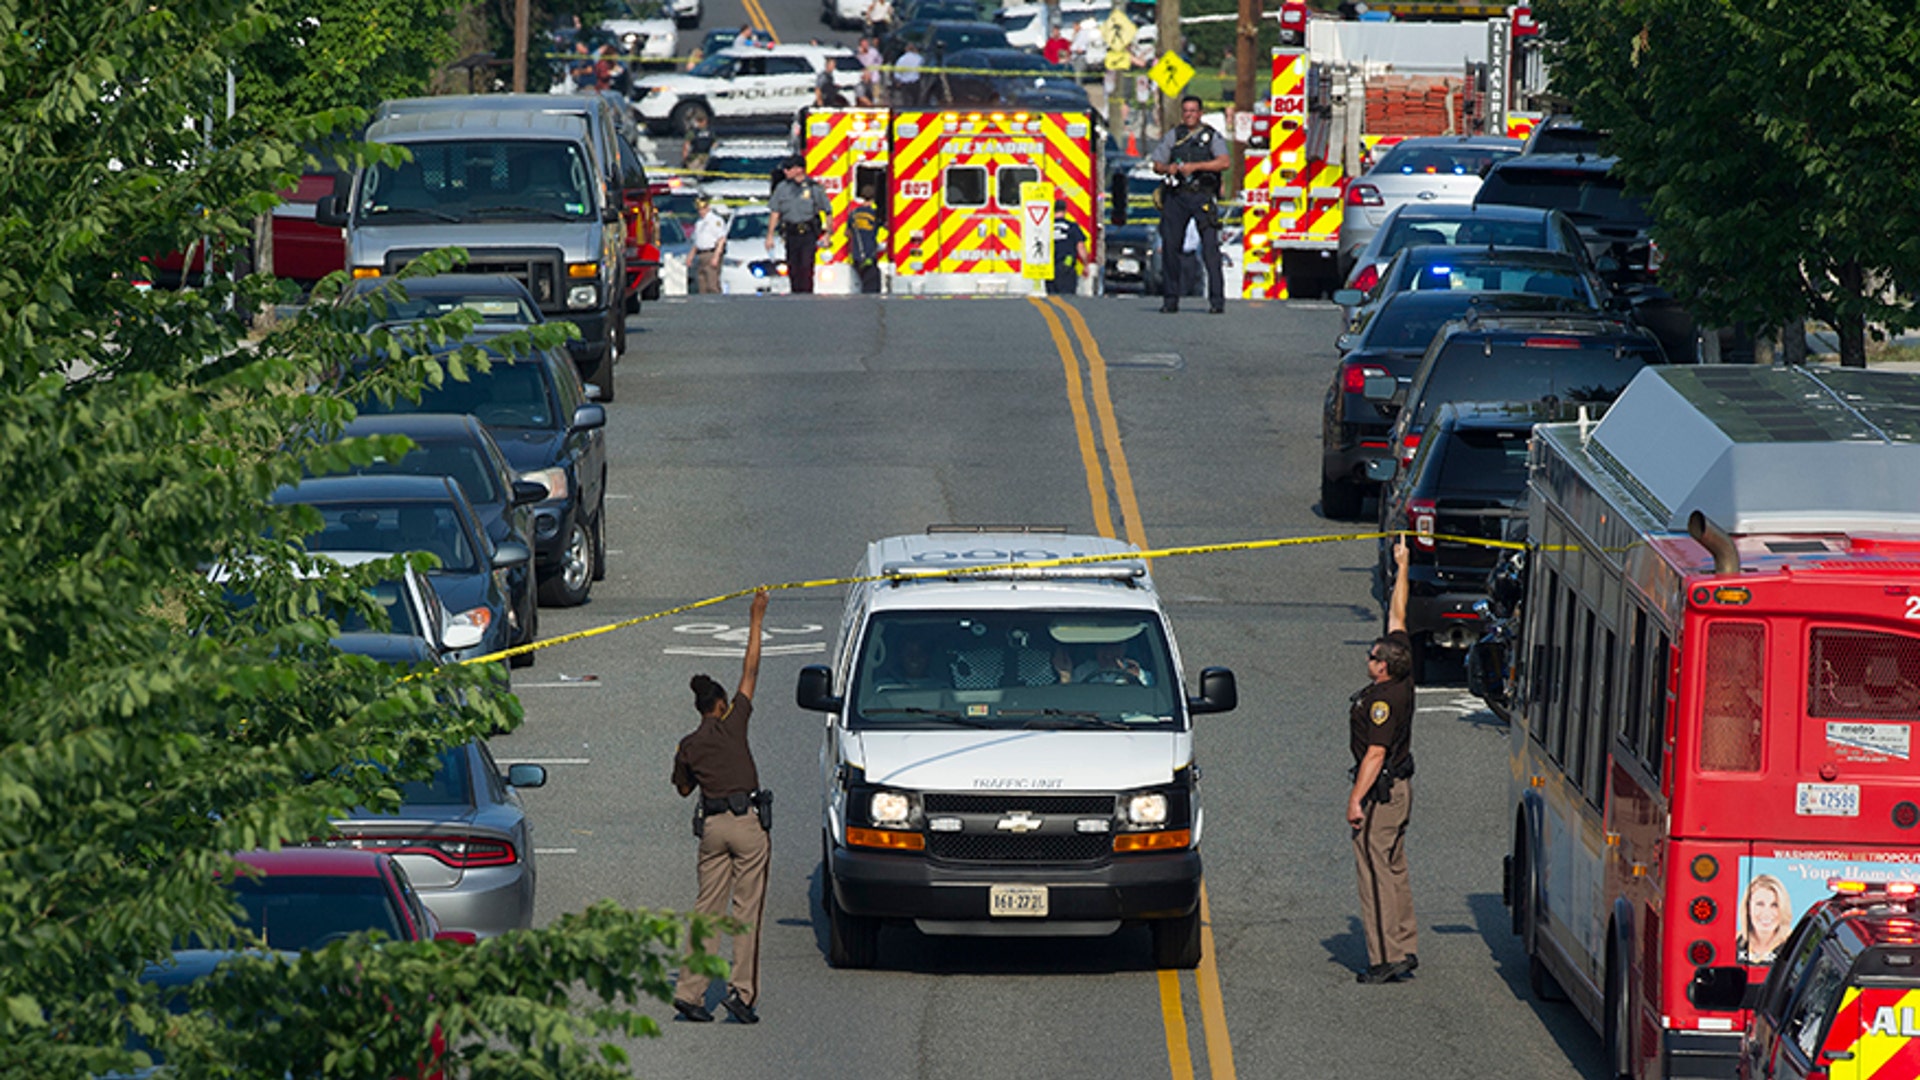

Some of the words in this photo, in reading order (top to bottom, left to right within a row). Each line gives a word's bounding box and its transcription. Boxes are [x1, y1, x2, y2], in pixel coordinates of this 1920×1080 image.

[1490, 21, 1503, 136] ALEXANDRIA
[728, 86, 808, 100] POLICE
[1274, 97, 1304, 114] 804
[941, 142, 1045, 155] ALEXANDRIA
[950, 249, 1021, 260] AMBULAN
[1773, 850, 1848, 861] WASHINGTON
[1844, 866, 1893, 882] Home
[1870, 1006, 1920, 1037] AL
